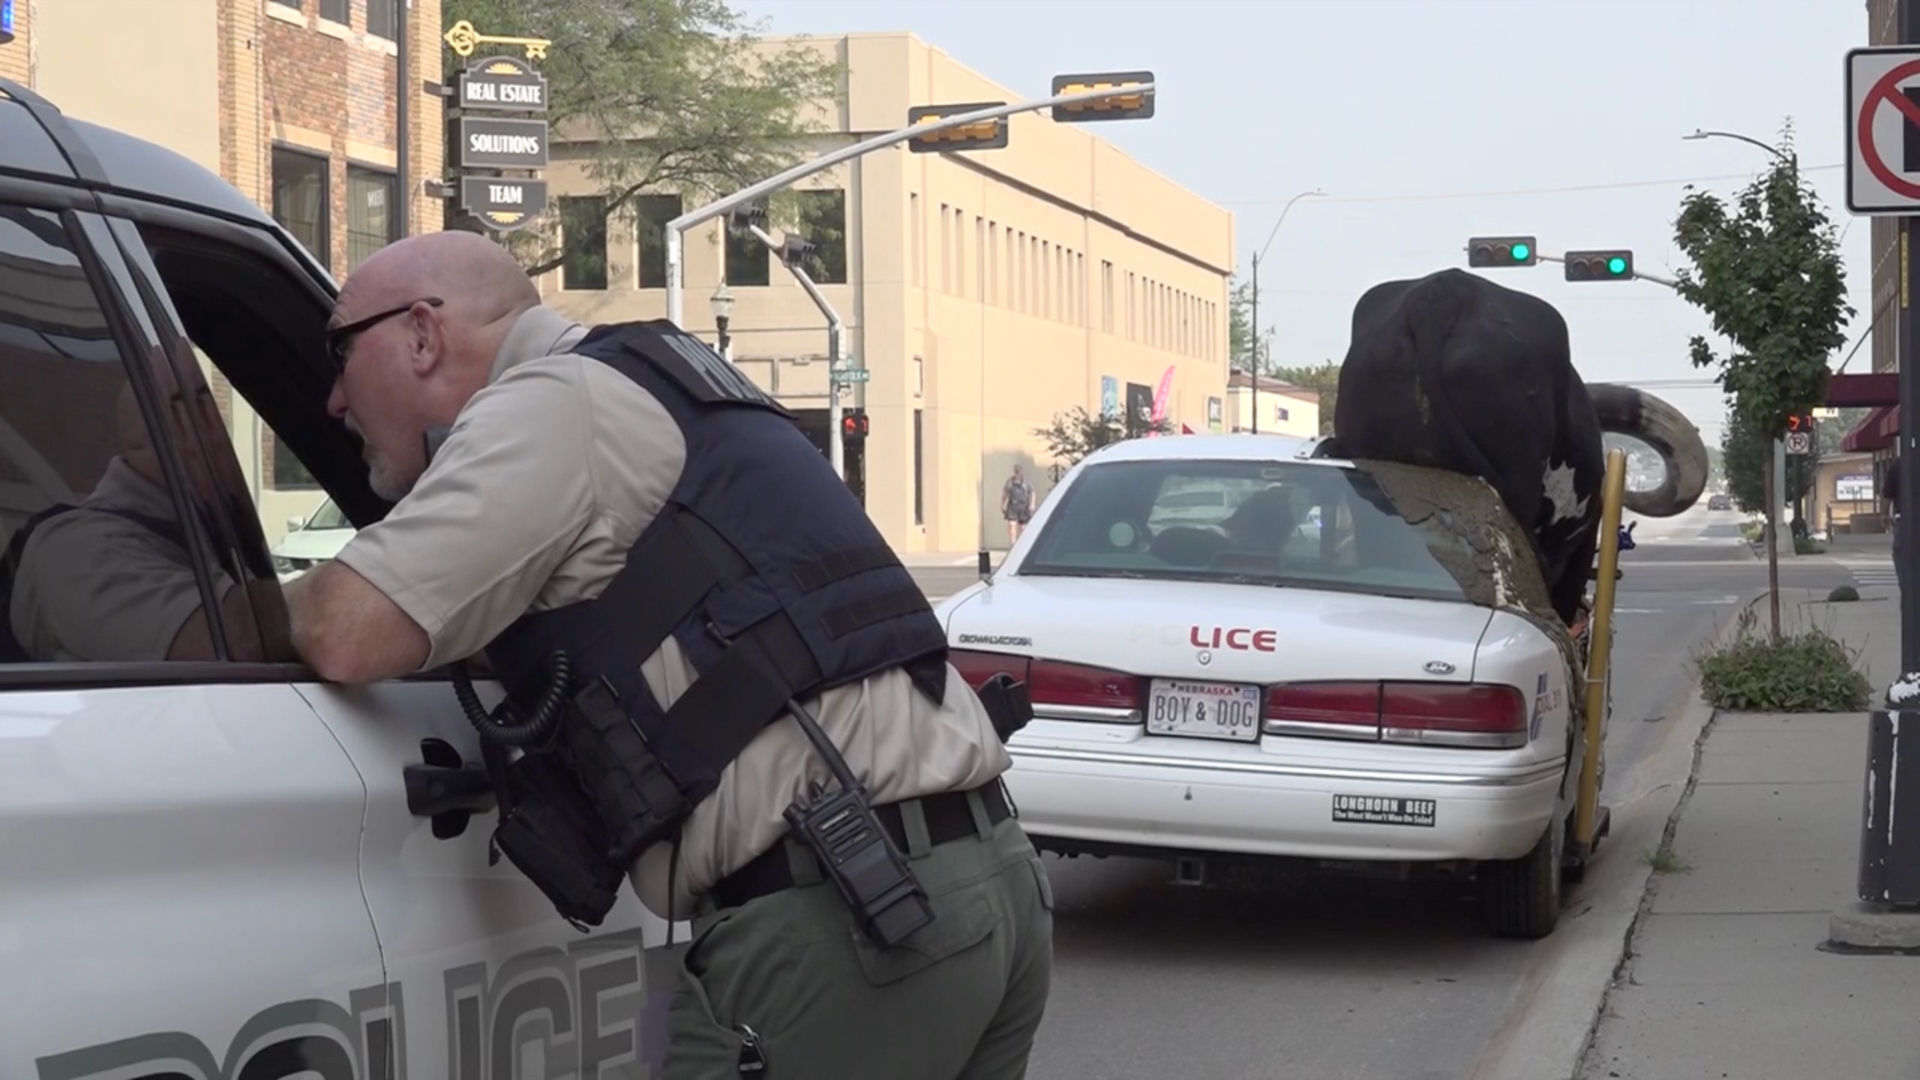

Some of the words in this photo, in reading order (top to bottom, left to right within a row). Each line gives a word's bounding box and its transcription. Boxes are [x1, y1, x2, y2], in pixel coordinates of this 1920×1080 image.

[466, 82, 497, 101] REAL
[500, 85, 541, 103] ESTATE
[470, 134, 539, 154] SOLUTIONS
[489, 185, 523, 203] TEAM
[1176, 684, 1234, 697] NEBRASKA
[1154, 694, 1191, 723] BOY
[1195, 701, 1207, 722] &
[1216, 698, 1254, 728] DOG
[1334, 796, 1399, 812] LONGHORN
[1405, 800, 1434, 815] BEEF
